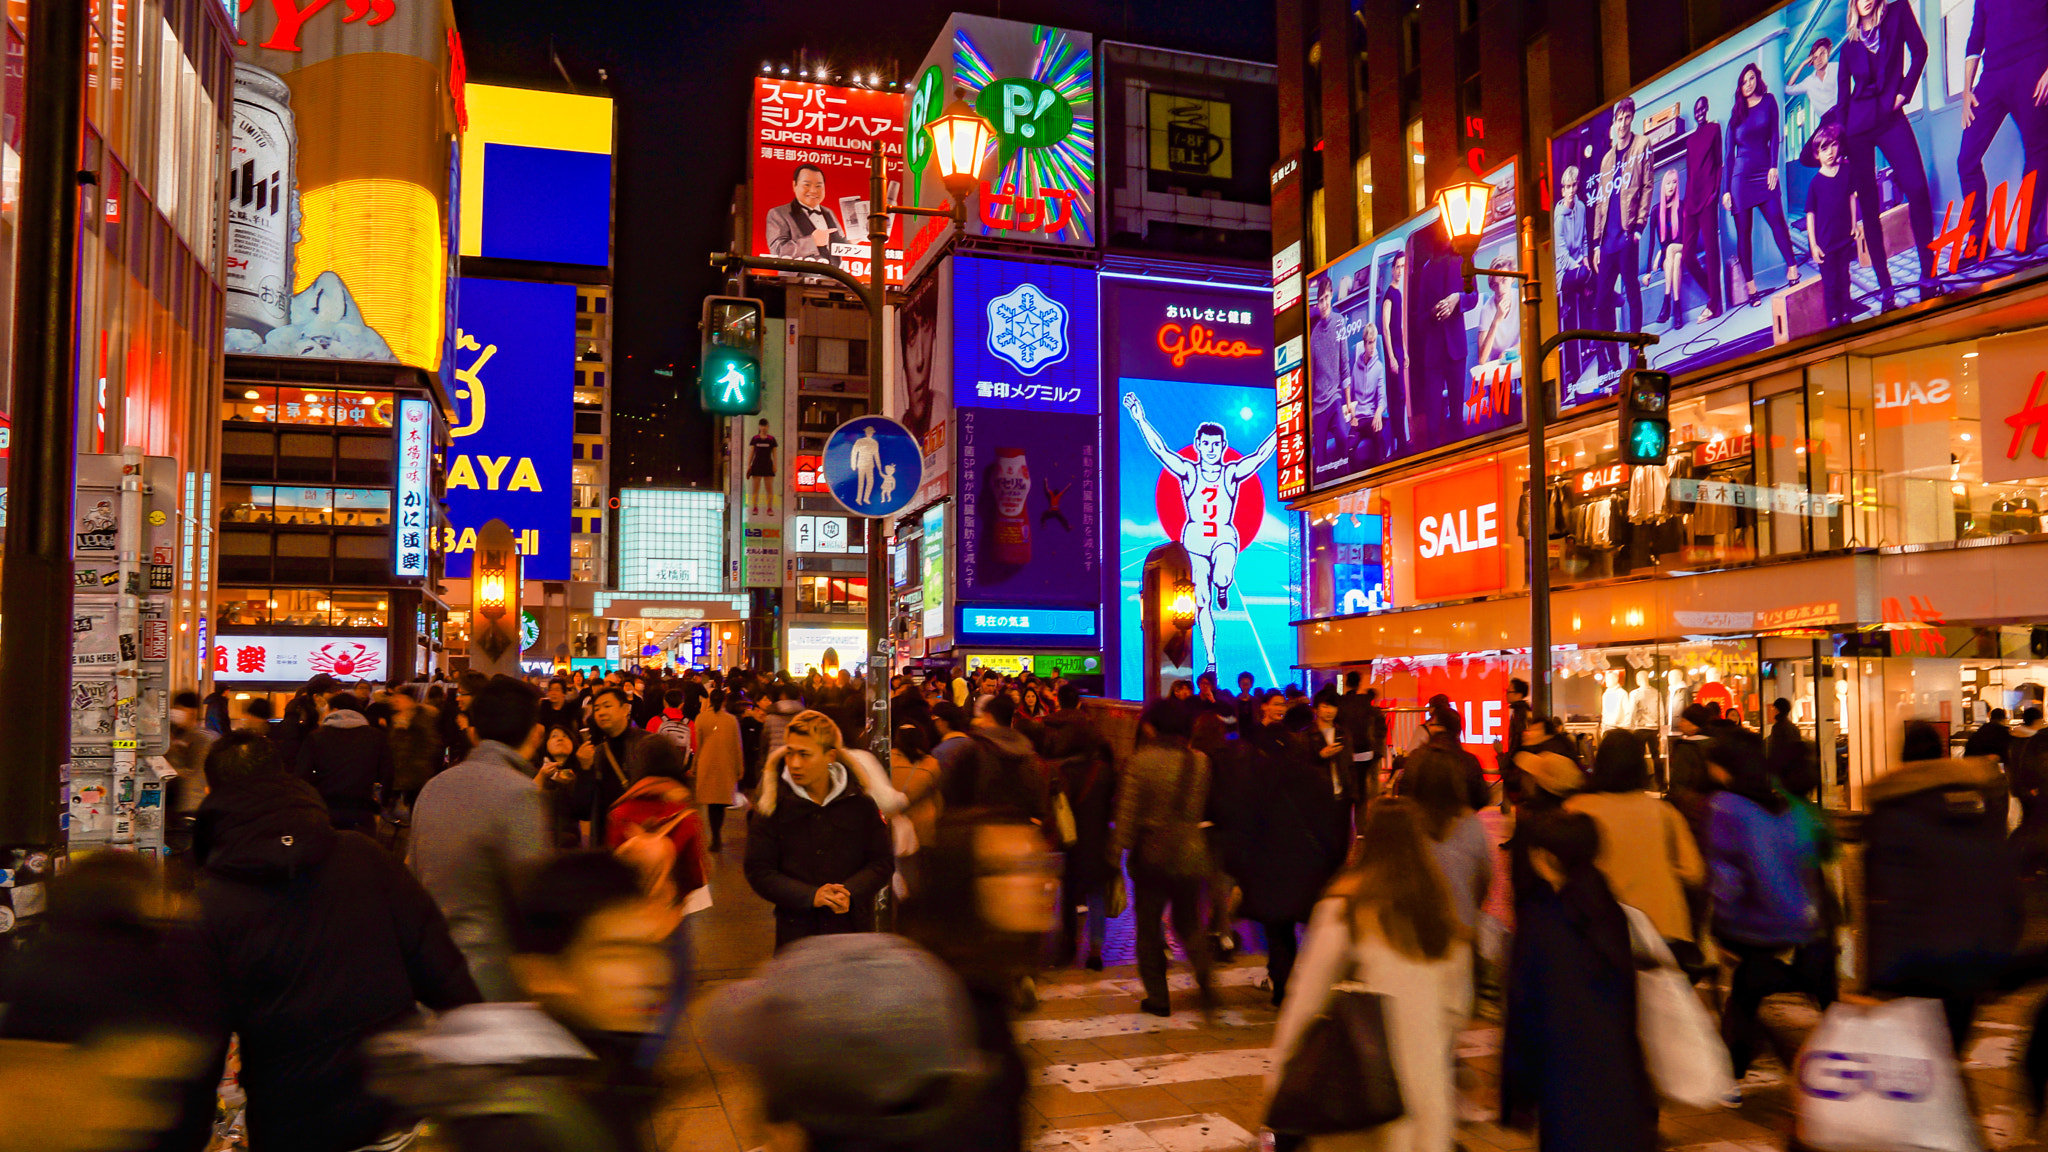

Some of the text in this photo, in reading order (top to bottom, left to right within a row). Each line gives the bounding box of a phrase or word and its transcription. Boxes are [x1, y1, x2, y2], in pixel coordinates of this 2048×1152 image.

[761, 84, 847, 109] スーパー
[1003, 83, 1057, 138] P!
[239, 120, 267, 148] LIMITED
[761, 105, 904, 136] ミリオンヘアー
[761, 129, 812, 144] SUPER
[816, 135, 872, 151] MILLION
[1586, 171, 1632, 207] ¥4,999
[979, 180, 1077, 234] ピップ
[1927, 169, 2038, 278] H&M
[1166, 304, 1252, 325] おいしさと健康
[1157, 323, 1263, 368] Glico
[976, 381, 1081, 402] 雪印メグミルク
[1465, 363, 1512, 426] H&M
[1292, 368, 1305, 481] インターネット
[1279, 422, 1291, 485] コミック
[1704, 435, 1751, 462] SALE
[1582, 465, 1622, 491] SALE
[1201, 484, 1219, 537] グリコ
[1419, 502, 1498, 559] SALE
[975, 615, 1030, 628] 現在の気温
[79, 655, 94, 663] WAS
